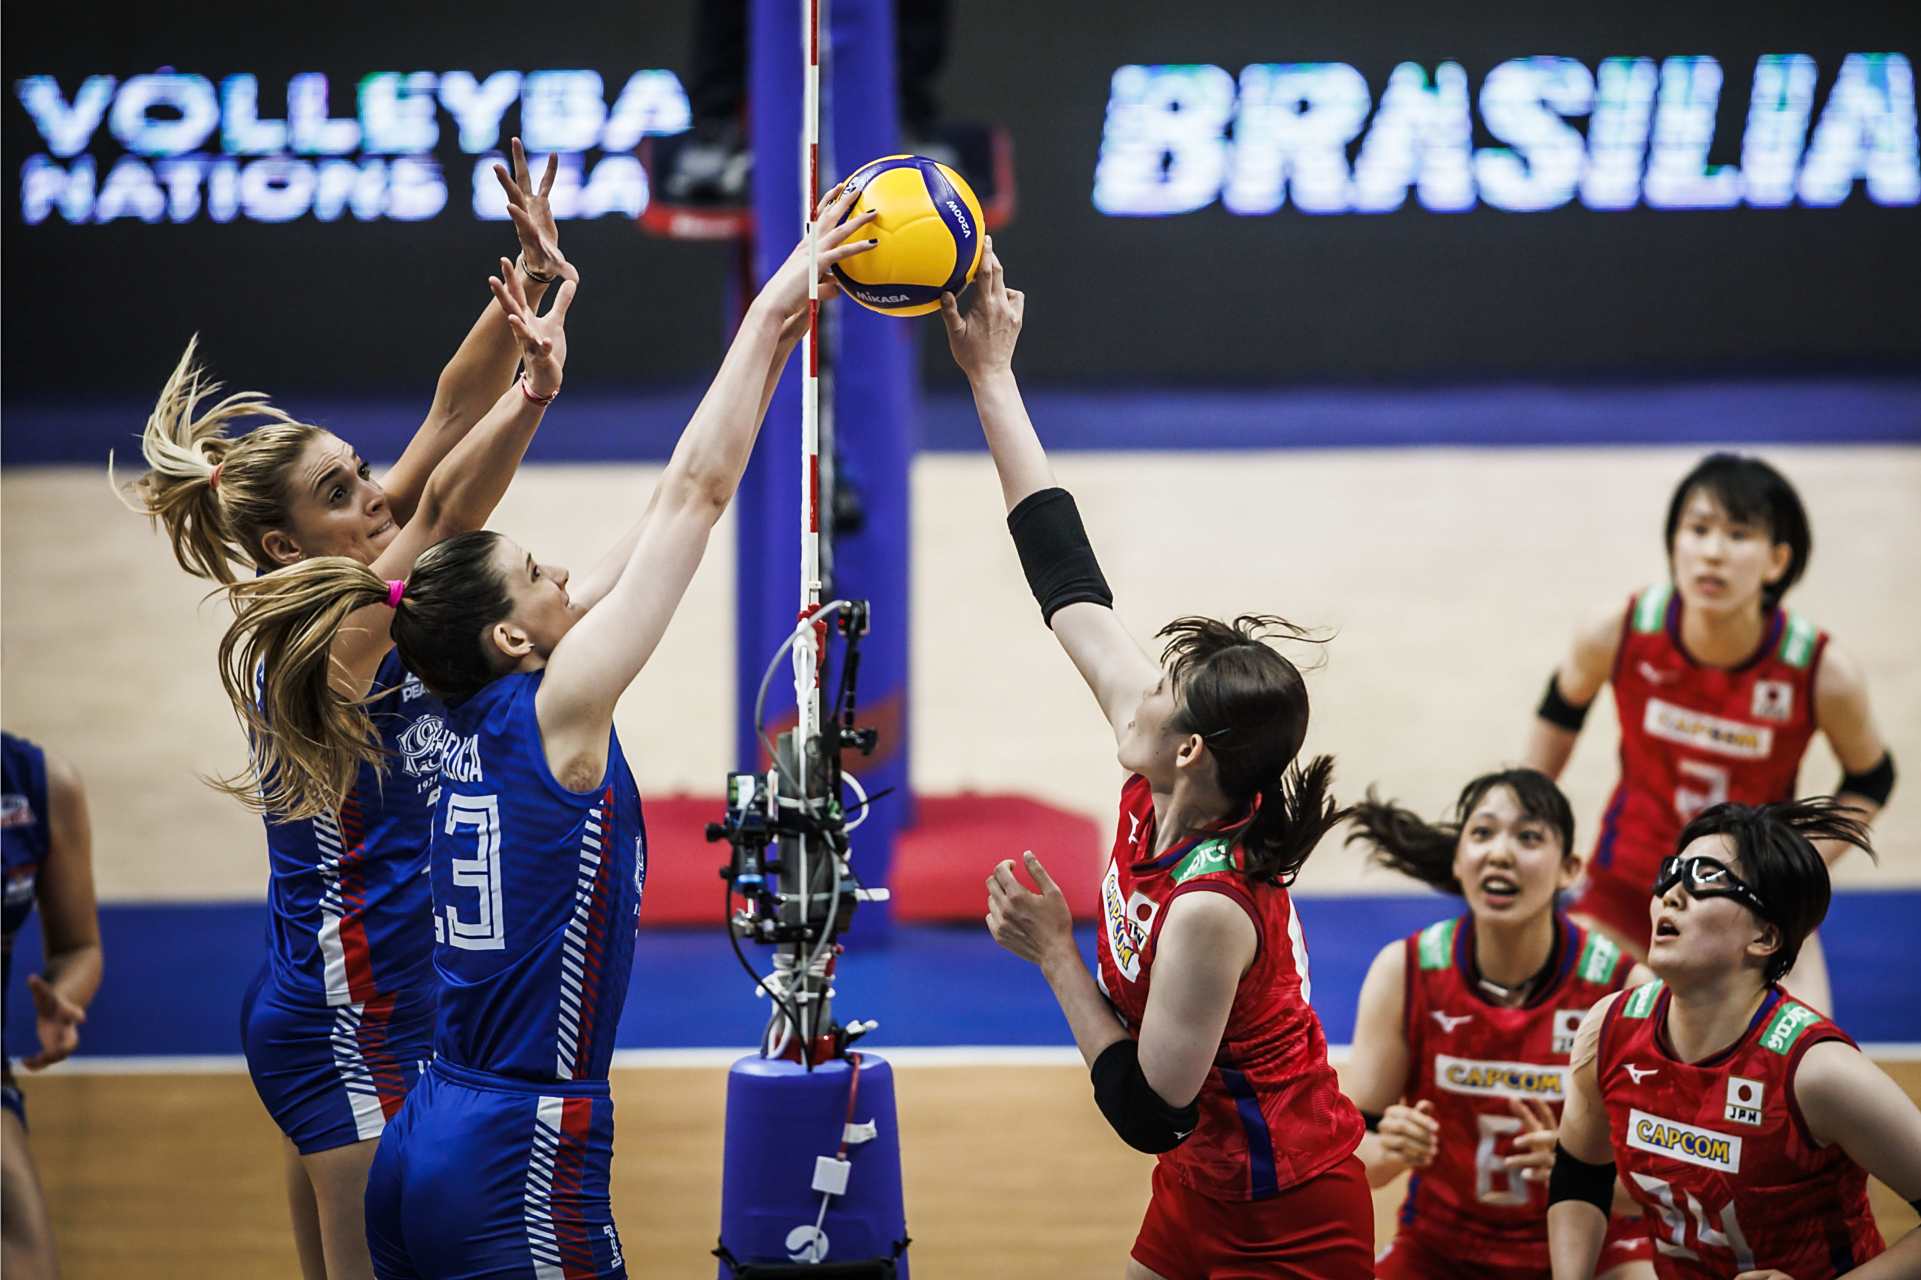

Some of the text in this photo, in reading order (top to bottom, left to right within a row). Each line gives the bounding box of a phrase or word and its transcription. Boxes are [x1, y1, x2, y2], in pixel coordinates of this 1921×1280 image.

[1092, 53, 1920, 214] BRASILIA
[20, 153, 449, 225] NATIONS
[946, 200, 971, 239] V200W
[402, 683, 430, 703] PEA
[432, 793, 505, 950] 3
[1446, 1064, 1562, 1095] CAPCOM
[1729, 1107, 1757, 1123] JPN
[1475, 1113, 1528, 1205] 6
[1636, 1119, 1731, 1164] CAPCOM
